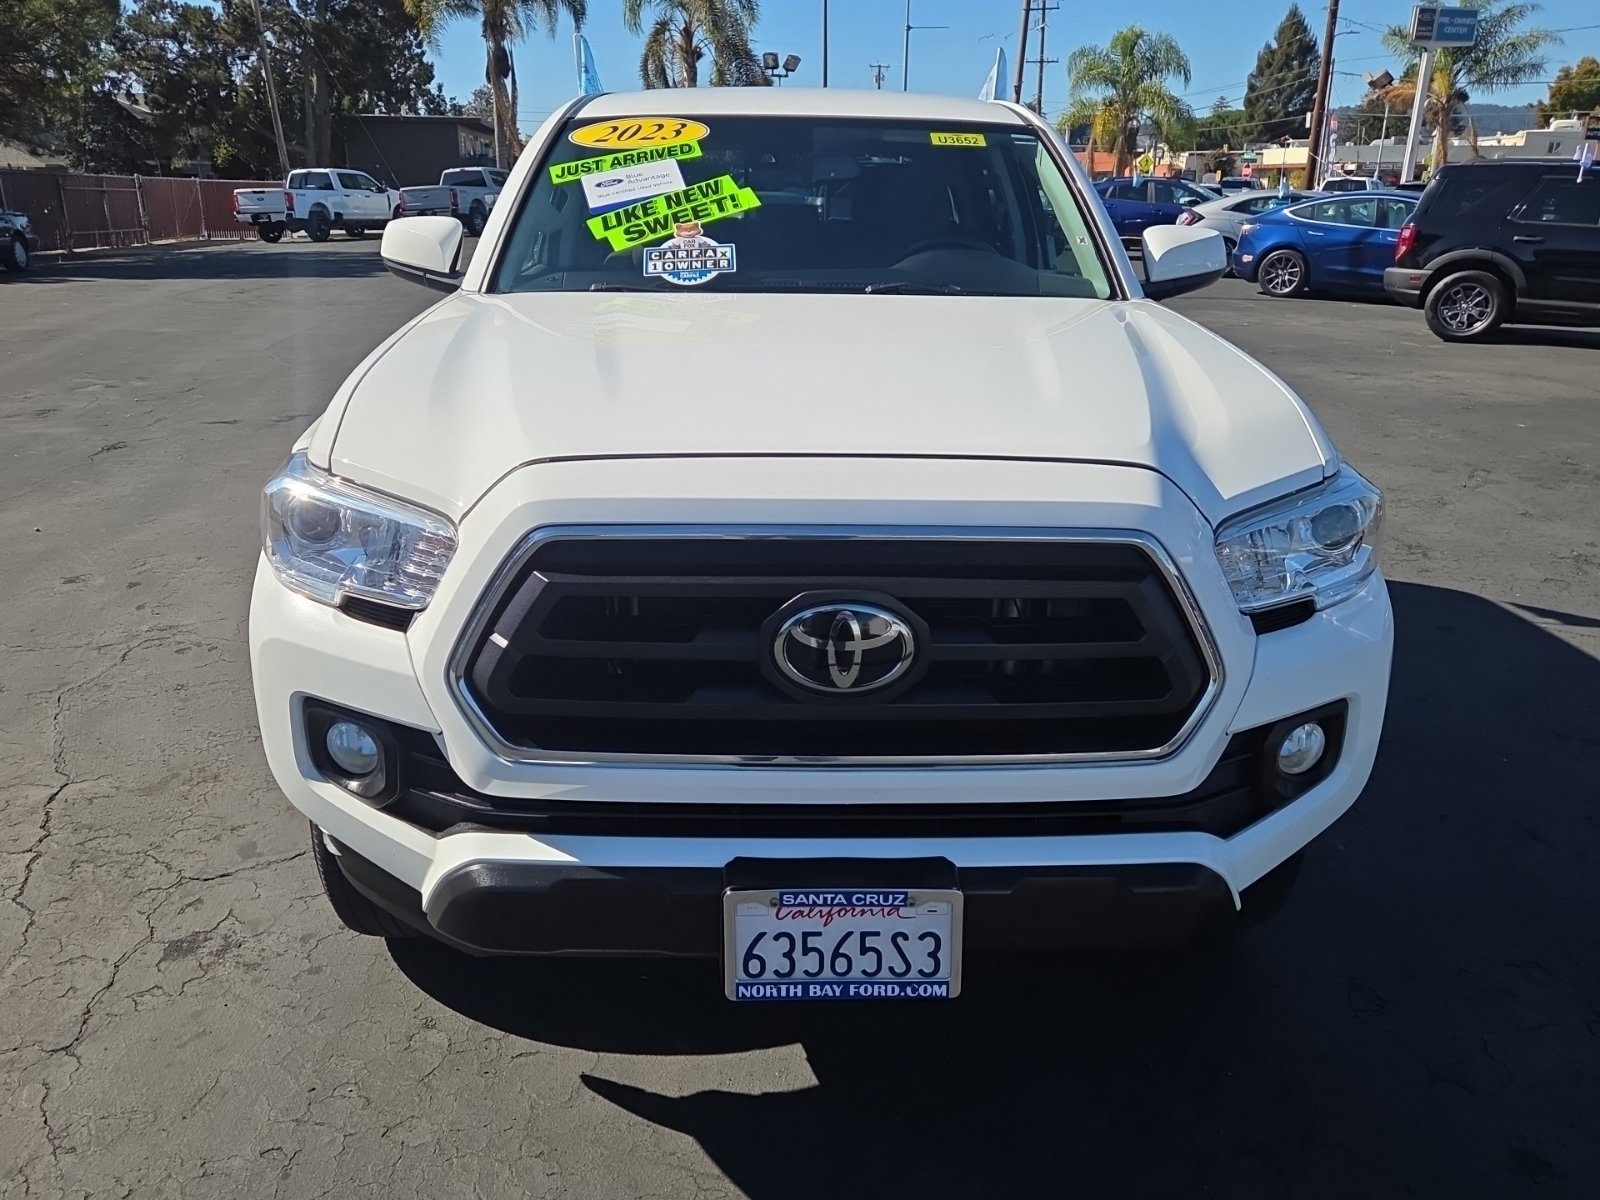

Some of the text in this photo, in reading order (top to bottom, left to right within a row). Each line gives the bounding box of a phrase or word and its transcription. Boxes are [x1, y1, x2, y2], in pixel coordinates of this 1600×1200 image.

[1444, 26, 1467, 34] CENTER
[593, 122, 688, 143] 2023
[937, 135, 979, 145] U3652
[555, 143, 693, 179] JUST ARRIVED
[625, 172, 644, 180] Blue
[627, 172, 671, 184] Advantage
[601, 179, 723, 232] LIKE NEW
[622, 193, 743, 243] SWEET!
[651, 249, 728, 260] CARFAX
[782, 894, 905, 905] SANTA CRUZ
[775, 906, 916, 927] California
[742, 930, 942, 979] 63565S3
[738, 984, 947, 998] NORTH BAY FORD.COM
